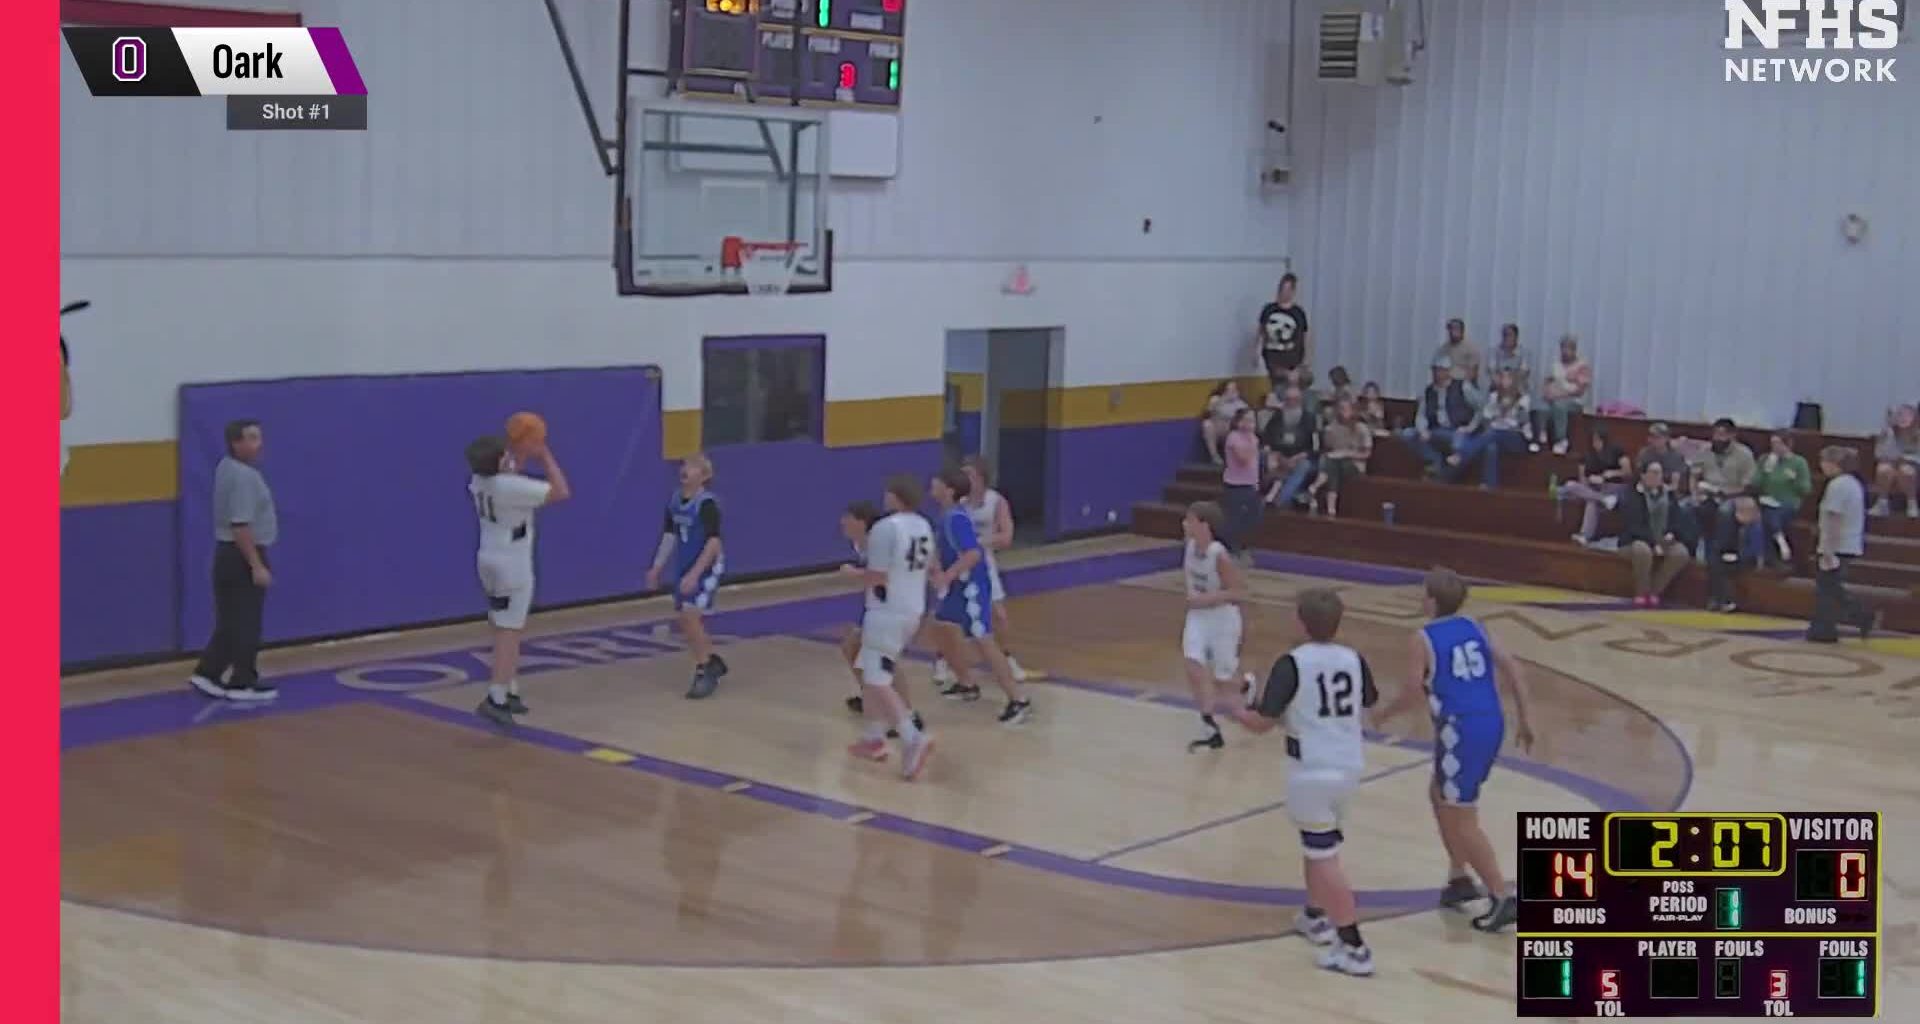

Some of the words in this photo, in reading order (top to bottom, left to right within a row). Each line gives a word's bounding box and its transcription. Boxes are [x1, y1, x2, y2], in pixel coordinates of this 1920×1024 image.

[906, 536, 929, 572] 45
[1452, 641, 1487, 682] 45
[1316, 671, 1354, 718] 12
